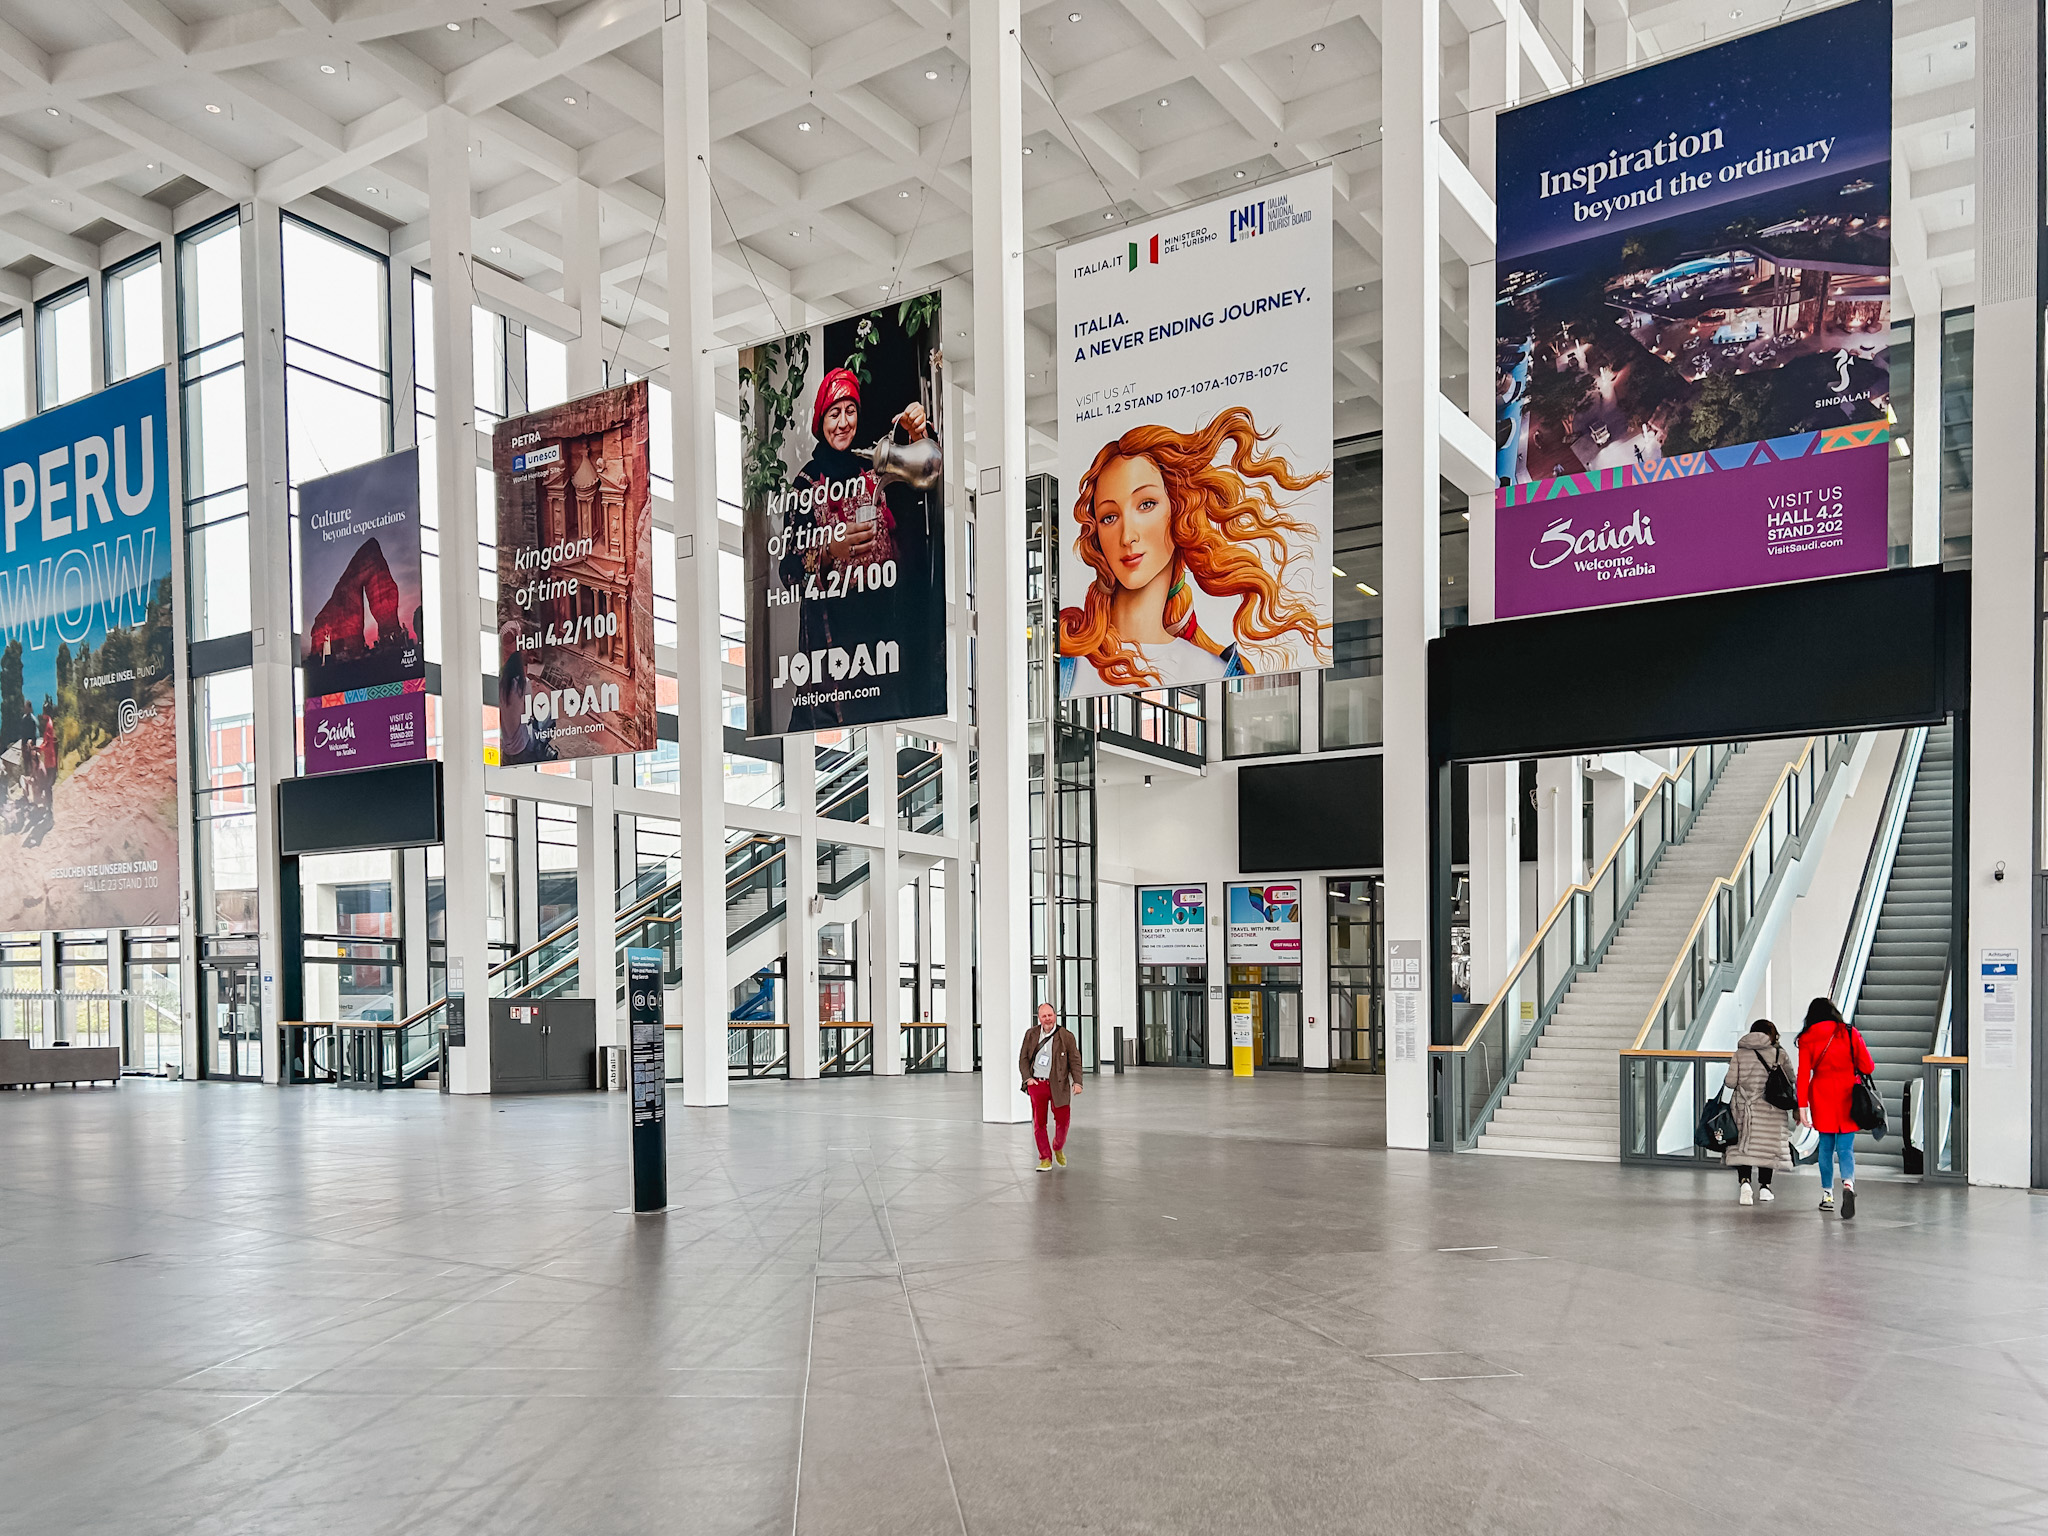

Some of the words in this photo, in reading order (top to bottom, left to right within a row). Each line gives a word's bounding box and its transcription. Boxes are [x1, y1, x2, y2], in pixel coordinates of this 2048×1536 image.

[1539, 127, 1724, 199] Inspiration
[1573, 178, 1664, 222] beyond
[1669, 170, 1712, 197] the
[1718, 136, 1836, 183] ordinary
[1267, 204, 1294, 221] NATIONAL
[1268, 194, 1288, 210] ITALIAN
[1230, 201, 1265, 243] ENIT
[1268, 215, 1291, 232] TOURIST
[1292, 210, 1312, 226] BOARD
[1165, 227, 1208, 245] MINISTERO
[1165, 242, 1180, 254] DEL
[1182, 232, 1218, 250] TURISMO
[1074, 255, 1123, 279] ITALIA.IT
[1074, 312, 1129, 338] ITALIA.
[1074, 347, 1086, 363] A
[1090, 331, 1144, 359] NEVER
[1149, 312, 1214, 343] ENDING
[1219, 287, 1311, 324] JOURNEY.
[1076, 406, 1103, 423] HALL
[1106, 403, 1122, 416] 1.2
[1124, 392, 1163, 411] STAND
[1166, 361, 1289, 400] 107-107A-107B-107C
[1076, 391, 1100, 407] VISIT
[1103, 387, 1119, 401] US
[1121, 382, 1136, 396] AT
[1815, 391, 1871, 409] SINDALAH
[511, 431, 541, 449] PETRA
[527, 450, 557, 464] unesco
[3, 415, 155, 554] PERU
[513, 474, 528, 485] World
[528, 469, 550, 481] Heritage
[550, 466, 561, 475] Site
[766, 475, 867, 516] kingdom
[1768, 491, 1813, 510] VISIT
[1818, 486, 1843, 502] US
[311, 508, 352, 530] Culture
[1768, 509, 1813, 528] HALL
[1816, 502, 1843, 521] 4.2
[322, 523, 352, 543] beyond
[353, 510, 406, 535] expectations
[1768, 524, 1814, 541] STAND
[1816, 519, 1843, 534] 202
[767, 526, 792, 561] of
[795, 521, 847, 550] time
[1529, 508, 1656, 569] Saudi
[1768, 539, 1843, 556] VisitSaudi.com
[514, 536, 593, 572] kingdom
[1573, 554, 1634, 573] Welcome
[1597, 570, 1611, 581] to
[1613, 562, 1656, 579] Arabia
[0, 527, 156, 651] WOW
[516, 580, 536, 610] of
[538, 577, 578, 601] time
[766, 584, 800, 608] Hall
[804, 560, 897, 600] 4.2/100
[516, 632, 542, 651] Hall
[545, 612, 617, 648] 4.2/100
[89, 673, 116, 688] TAQUILE
[137, 665, 156, 678] PUNO
[792, 685, 880, 706] visitjordan.com
[389, 713, 404, 723] VISIT
[405, 711, 413, 721] US
[389, 723, 404, 733] HALL
[404, 721, 413, 730] 4.2
[313, 717, 356, 748] Saudi
[390, 732, 405, 740] STAND
[405, 730, 414, 738] 202
[534, 722, 605, 742] visitjordan.com
[328, 742, 349, 751] Welcome
[342, 748, 357, 756] Arabia
[50, 866, 86, 879] BESUCHEN
[87, 865, 98, 877] SIE
[100, 862, 133, 875] UNSEREN
[133, 860, 158, 872] STAND
[83, 879, 106, 892] HALLE
[107, 879, 117, 891] 23
[119, 877, 142, 890] STAND
[144, 876, 158, 888] 100
